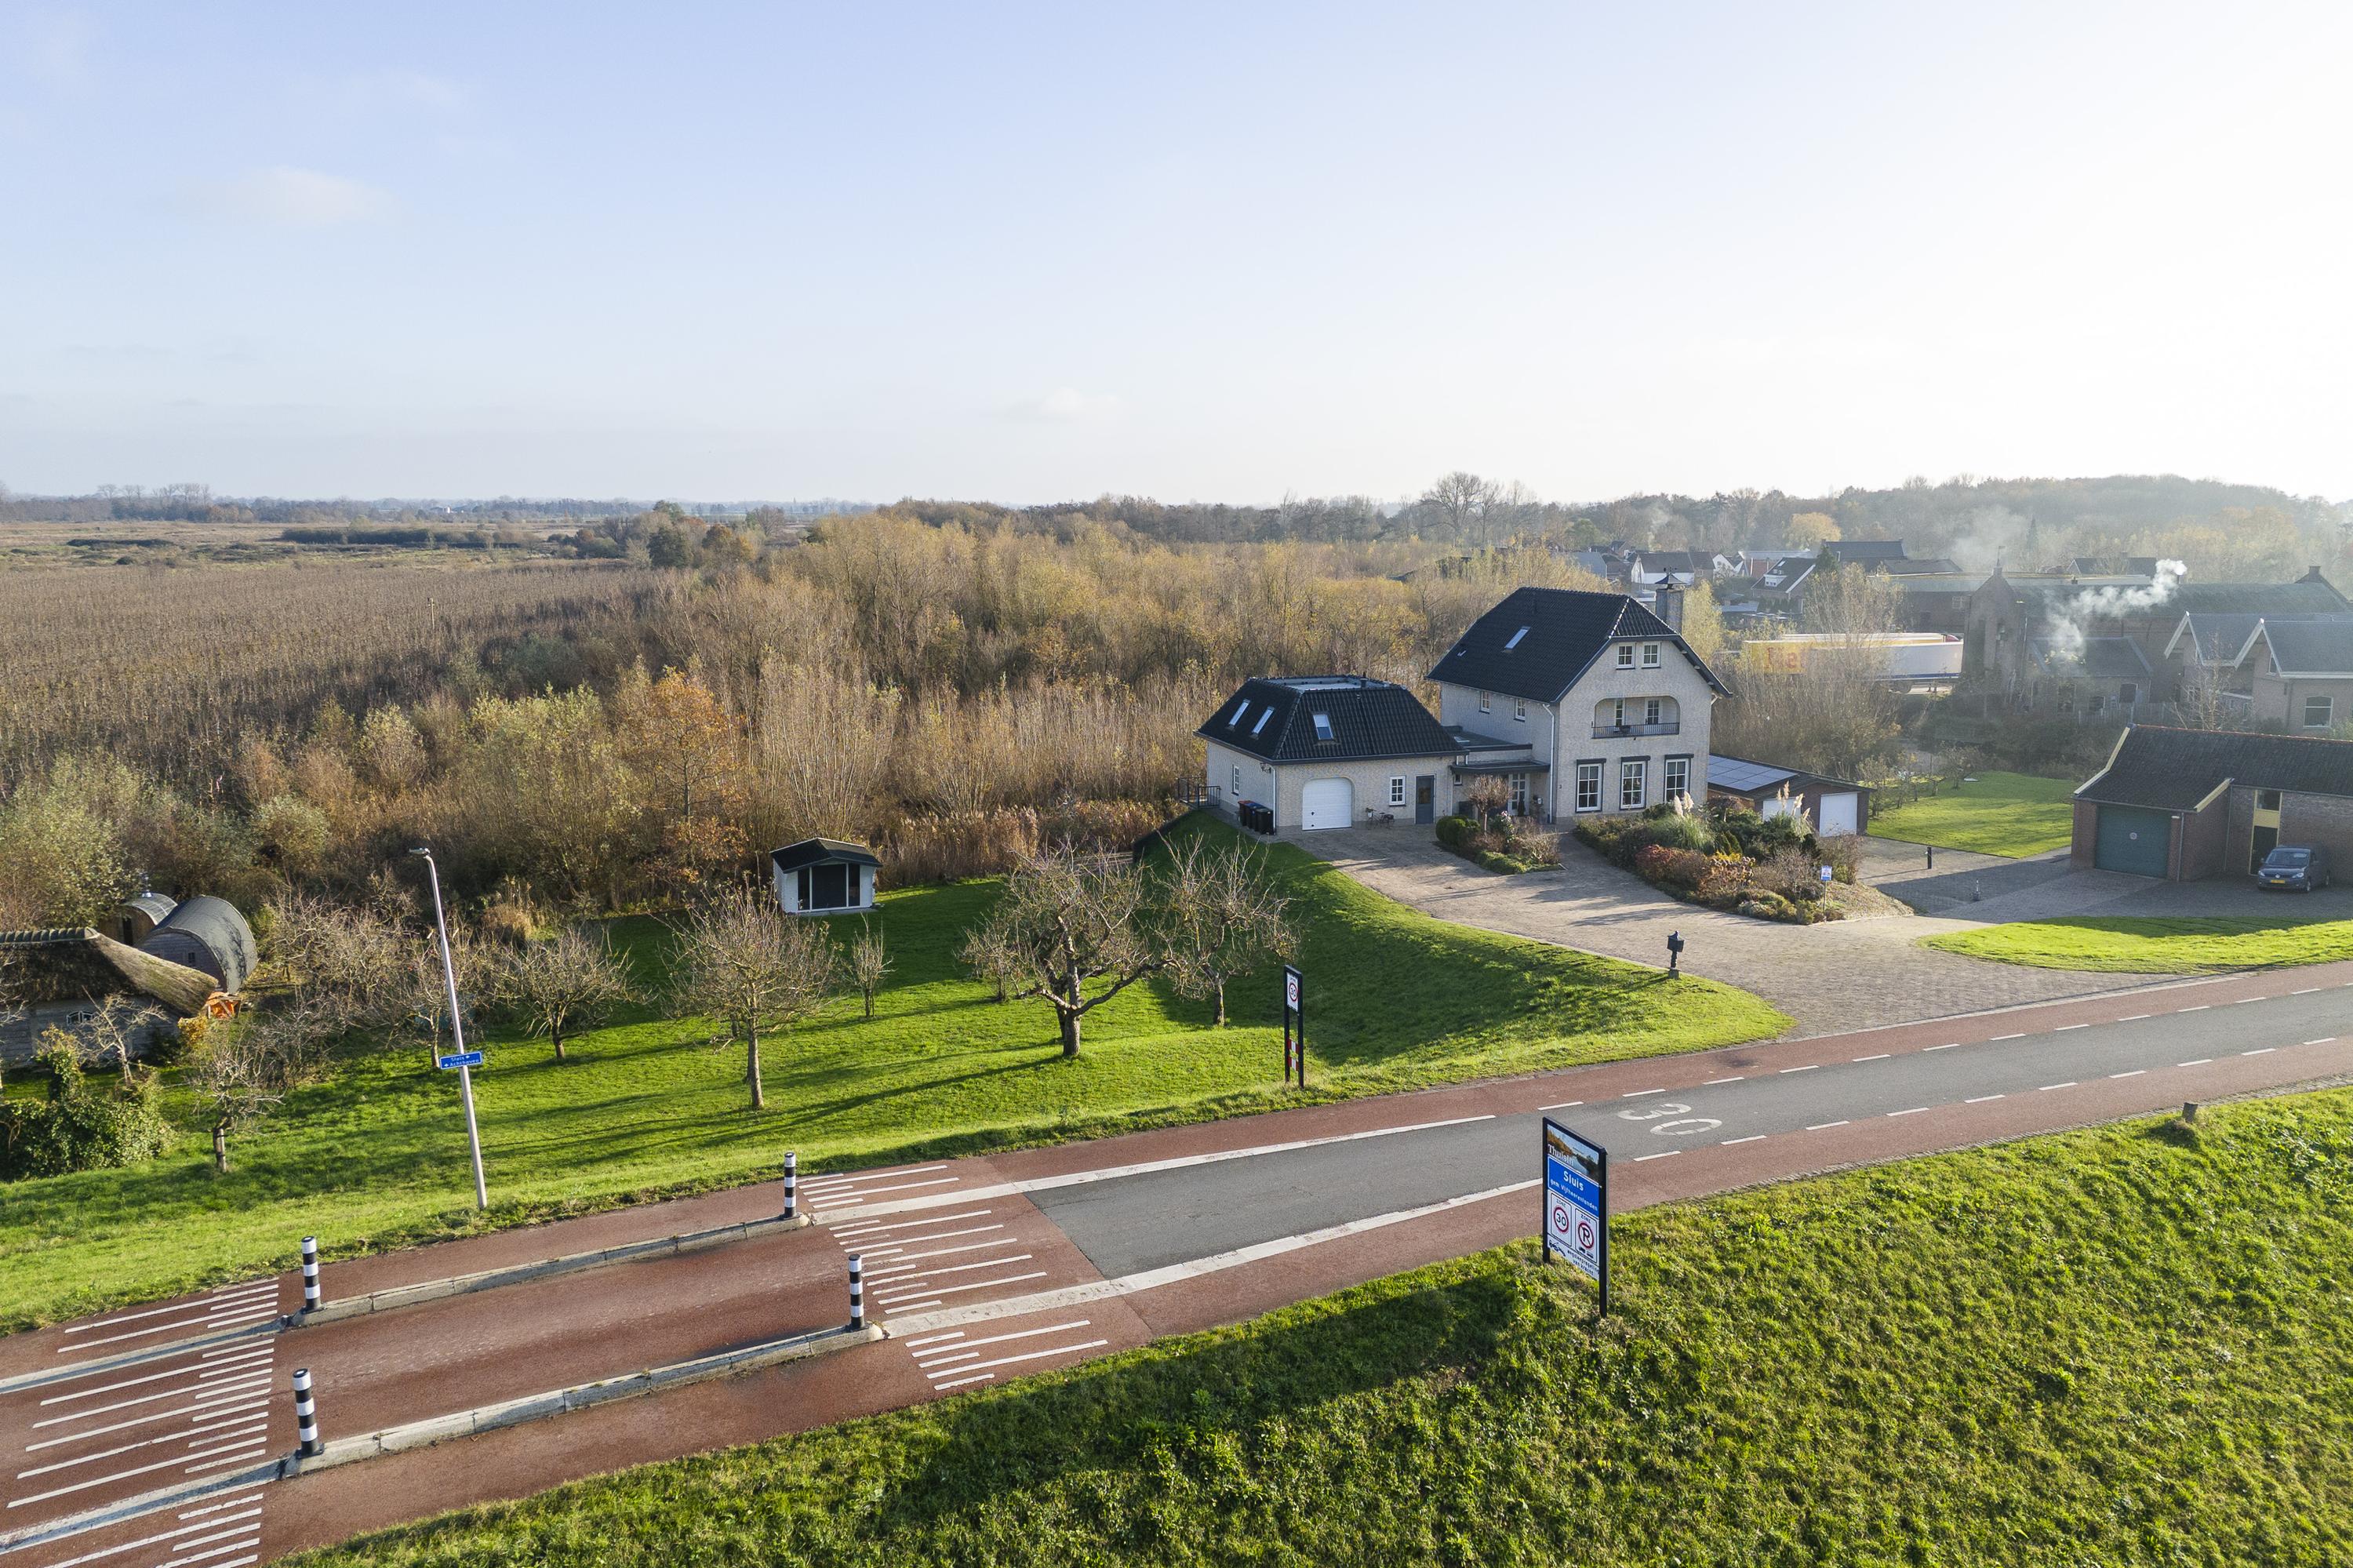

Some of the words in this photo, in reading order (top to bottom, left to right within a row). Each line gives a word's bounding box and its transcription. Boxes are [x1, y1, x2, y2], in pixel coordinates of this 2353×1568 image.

[1617, 1103, 1723, 1136] 30
[1563, 1170, 1584, 1191] Sluis
[1556, 1213, 1566, 1227] 30
[1580, 1213, 1591, 1224] ZONE
